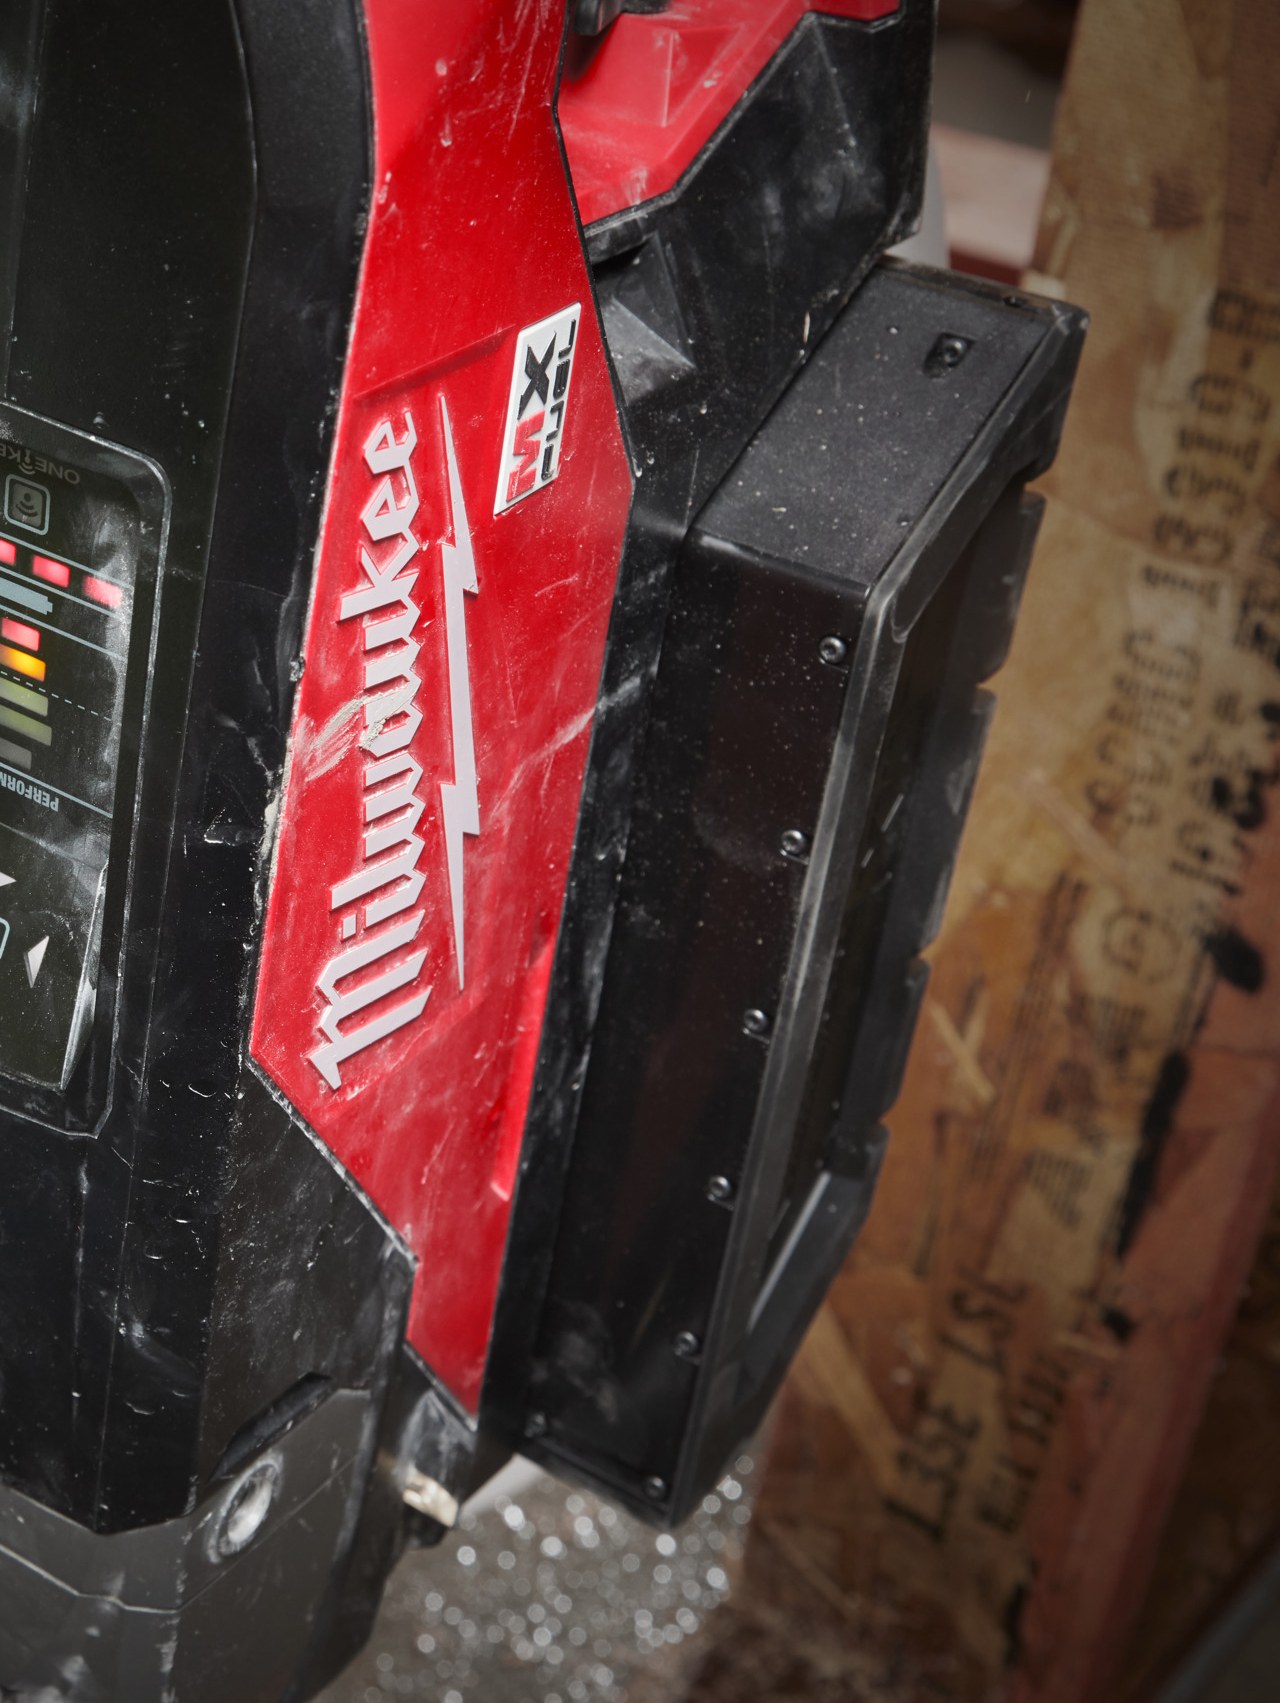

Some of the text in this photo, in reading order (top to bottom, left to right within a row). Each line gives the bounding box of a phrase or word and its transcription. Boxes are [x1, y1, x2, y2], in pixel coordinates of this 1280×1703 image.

[35, 455, 80, 485] ONE
[506, 329, 556, 503] MX
[541, 318, 576, 482] FUEL
[309, 408, 433, 1090] Milwaukee
